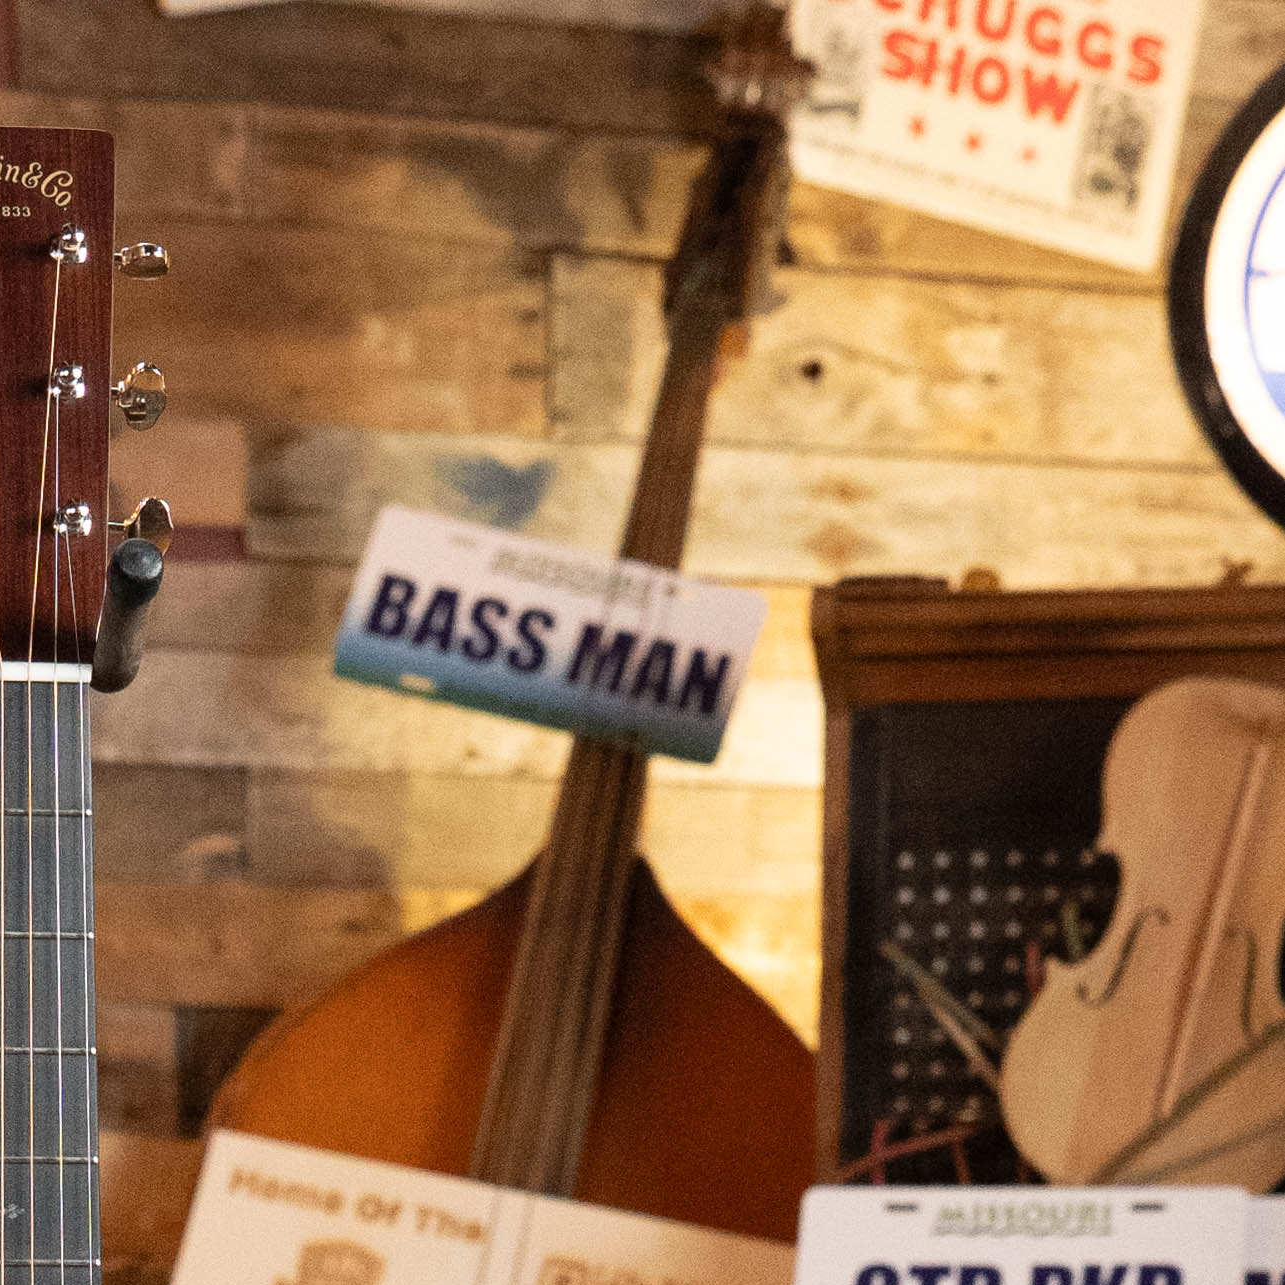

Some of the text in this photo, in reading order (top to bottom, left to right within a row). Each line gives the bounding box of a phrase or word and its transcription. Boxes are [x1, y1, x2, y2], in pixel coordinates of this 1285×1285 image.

[882, 30, 1079, 125] SHOW
[365, 573, 555, 675] BASS
[566, 620, 731, 715] MAN
